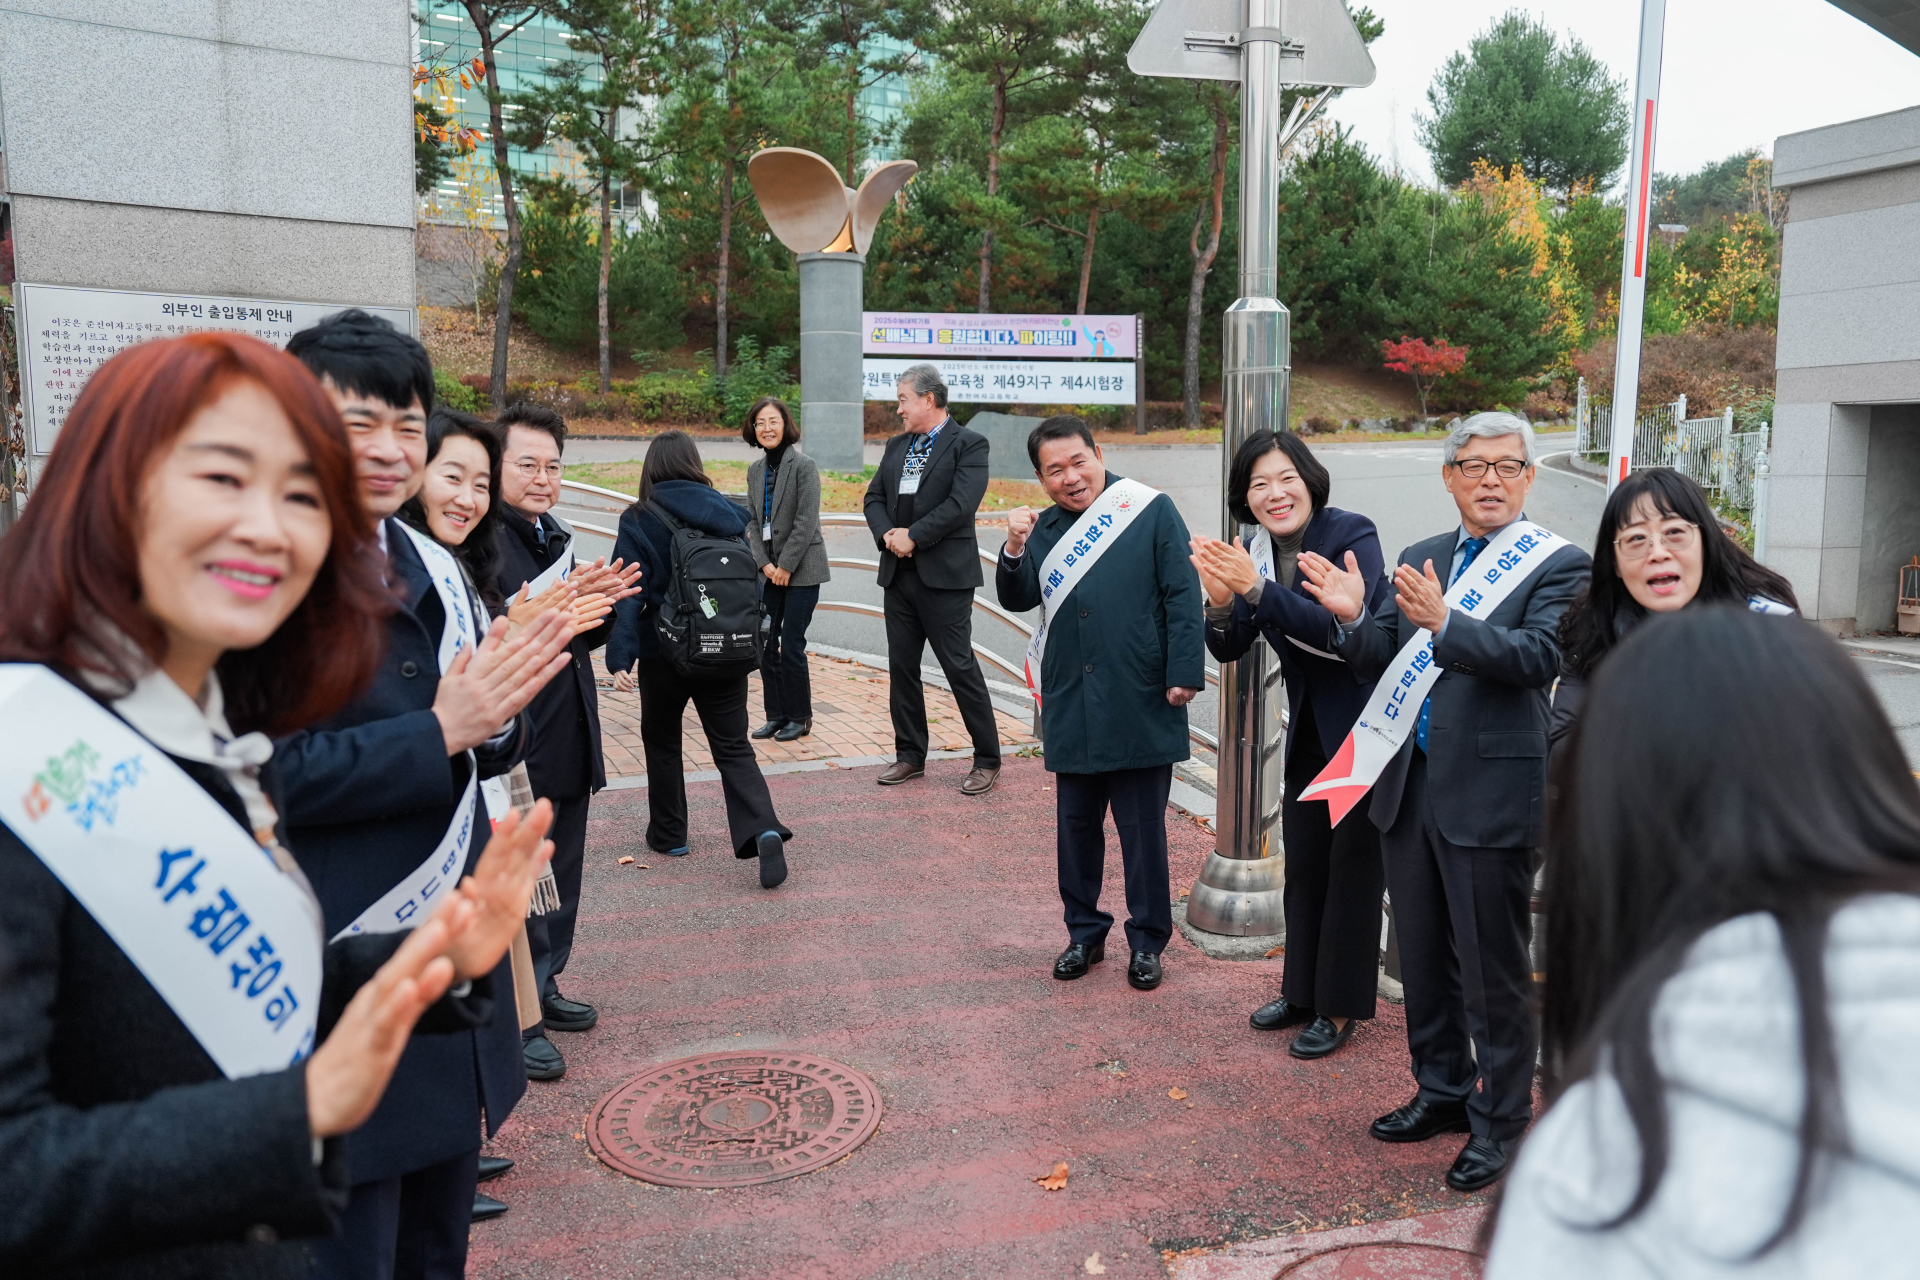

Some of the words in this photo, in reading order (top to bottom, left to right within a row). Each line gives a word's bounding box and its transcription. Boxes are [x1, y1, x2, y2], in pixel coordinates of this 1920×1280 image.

[162, 303, 203, 318] 외부인
[208, 305, 262, 321] 출입통제
[266, 308, 293, 323] 안내
[51, 318, 81, 328] 이곳은
[874, 316, 930, 325] 2025수능대박기원
[41, 329, 71, 340] 체력을
[79, 332, 108, 341] 기르고
[871, 327, 932, 344] 선배님들
[1019, 330, 1076, 345] 파이팅!!
[42, 342, 82, 353] 학습권과
[43, 355, 93, 366] 보장받아야
[52, 368, 71, 377] 이에
[993, 374, 1053, 390] 제49지구
[1060, 375, 1124, 391] 제4시험장
[1063, 514, 1113, 567] 수험생의
[1484, 528, 1552, 585] 수험생의
[155, 847, 299, 1033] 수험생의
